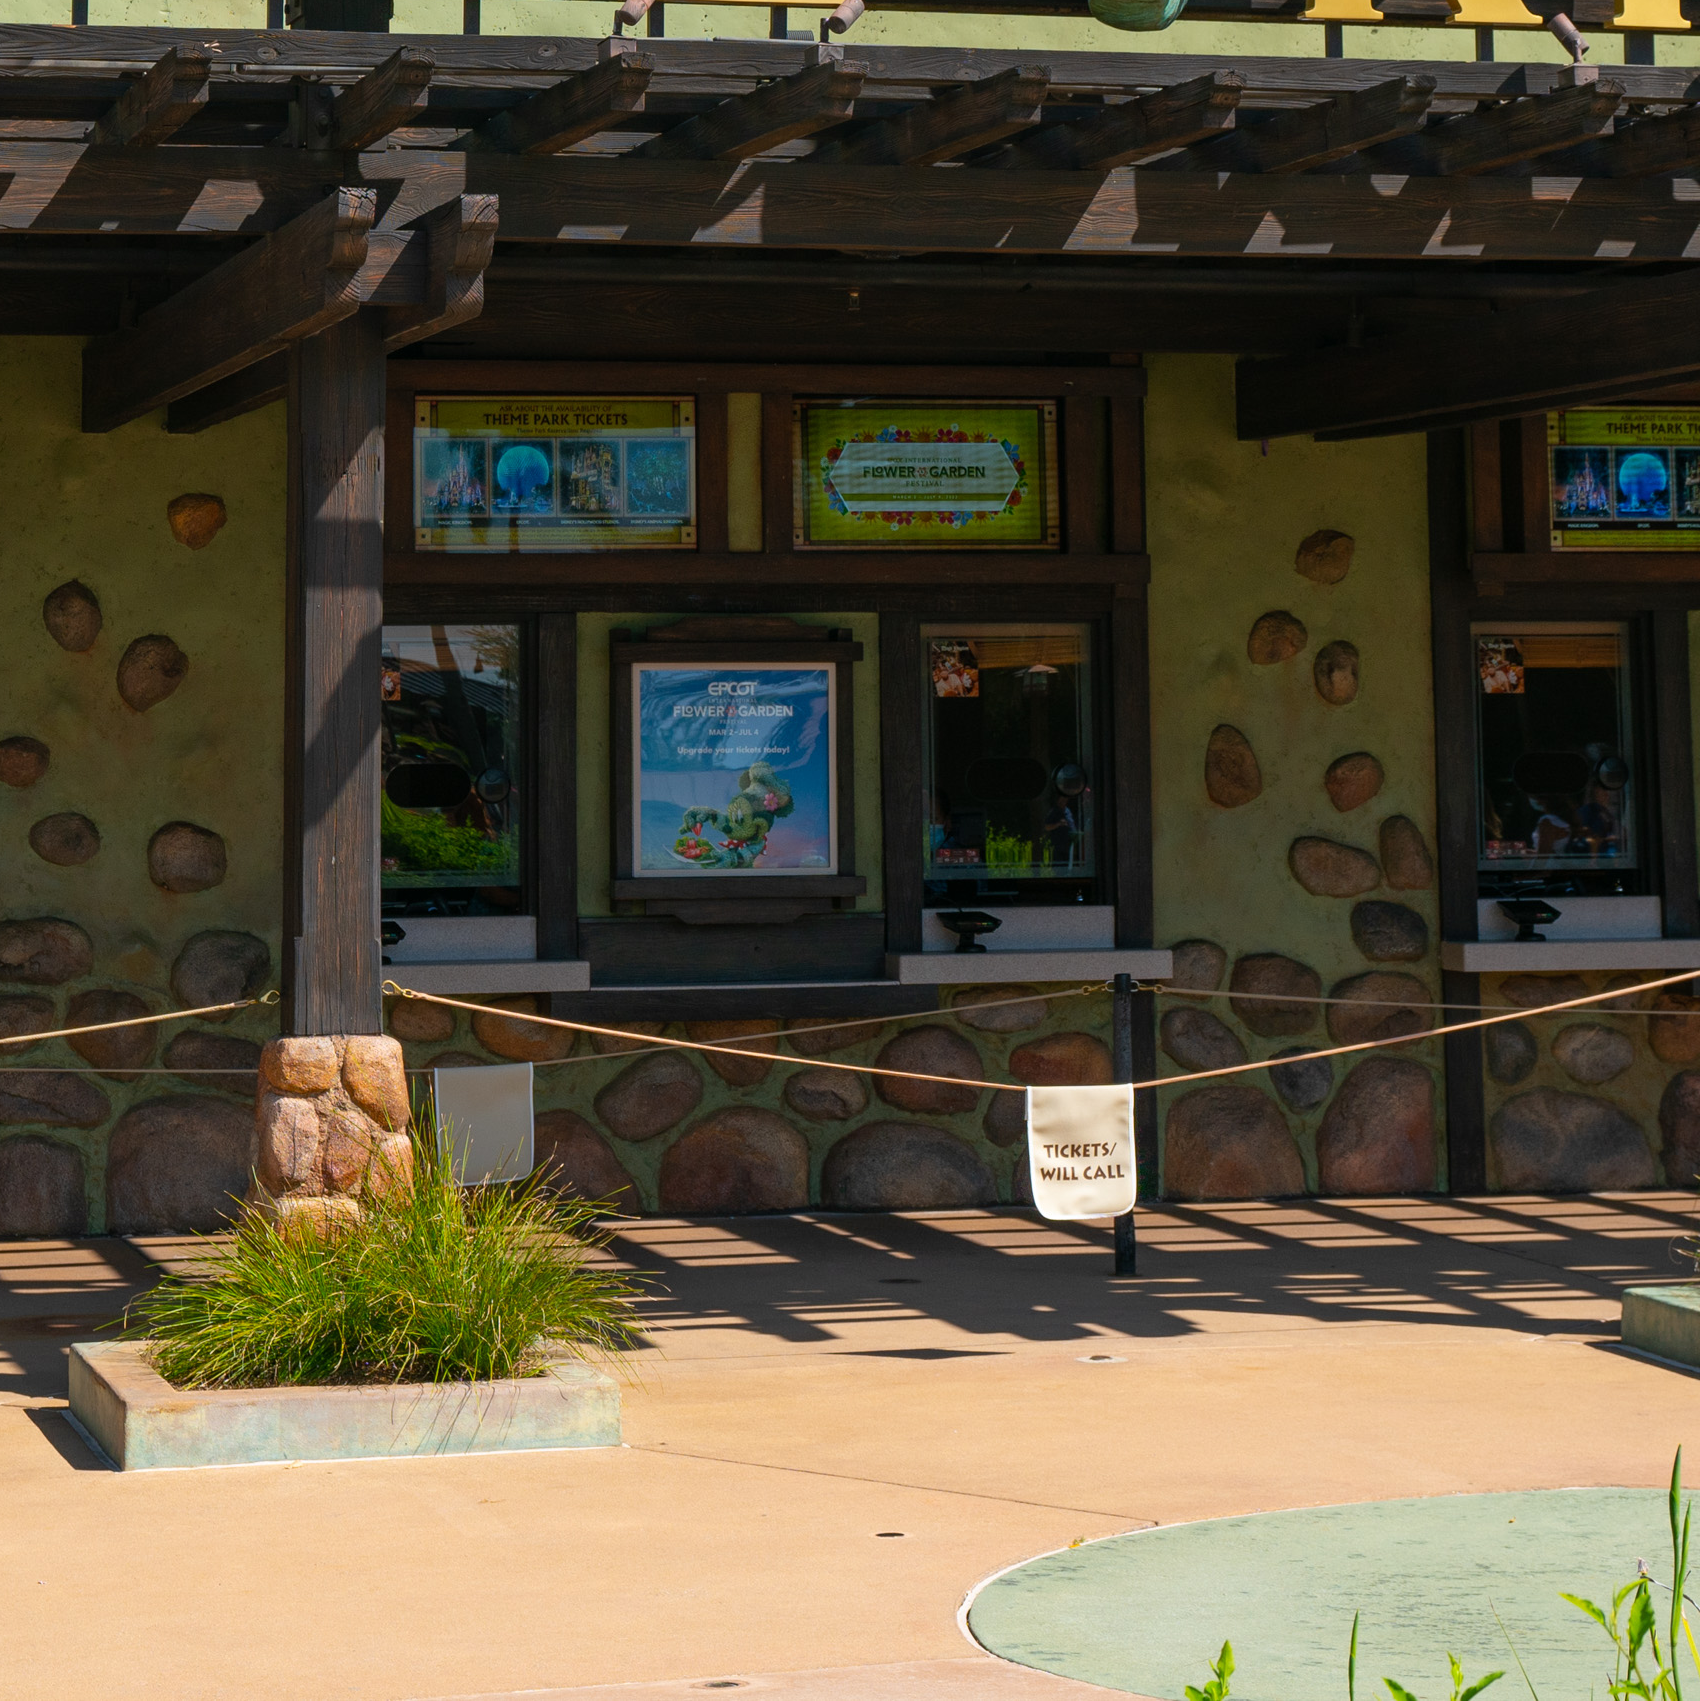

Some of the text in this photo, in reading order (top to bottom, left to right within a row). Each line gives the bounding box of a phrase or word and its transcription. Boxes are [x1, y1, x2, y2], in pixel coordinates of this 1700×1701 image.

[484, 414, 628, 425] THEME PARK TICKETS
[1606, 423, 1647, 434] THEME
[1651, 423, 1682, 434] PARK
[863, 466, 986, 478] FLOWER GARDEN
[708, 681, 758, 696] EPCOT
[673, 705, 794, 718] FLOWER GARDEN
[677, 746, 713, 755] Upgrade
[736, 746, 761, 754] tickets
[764, 746, 790, 755] today!
[1043, 1142, 1117, 1159] TICKETS/
[1040, 1164, 1125, 1182] WILL CALL
